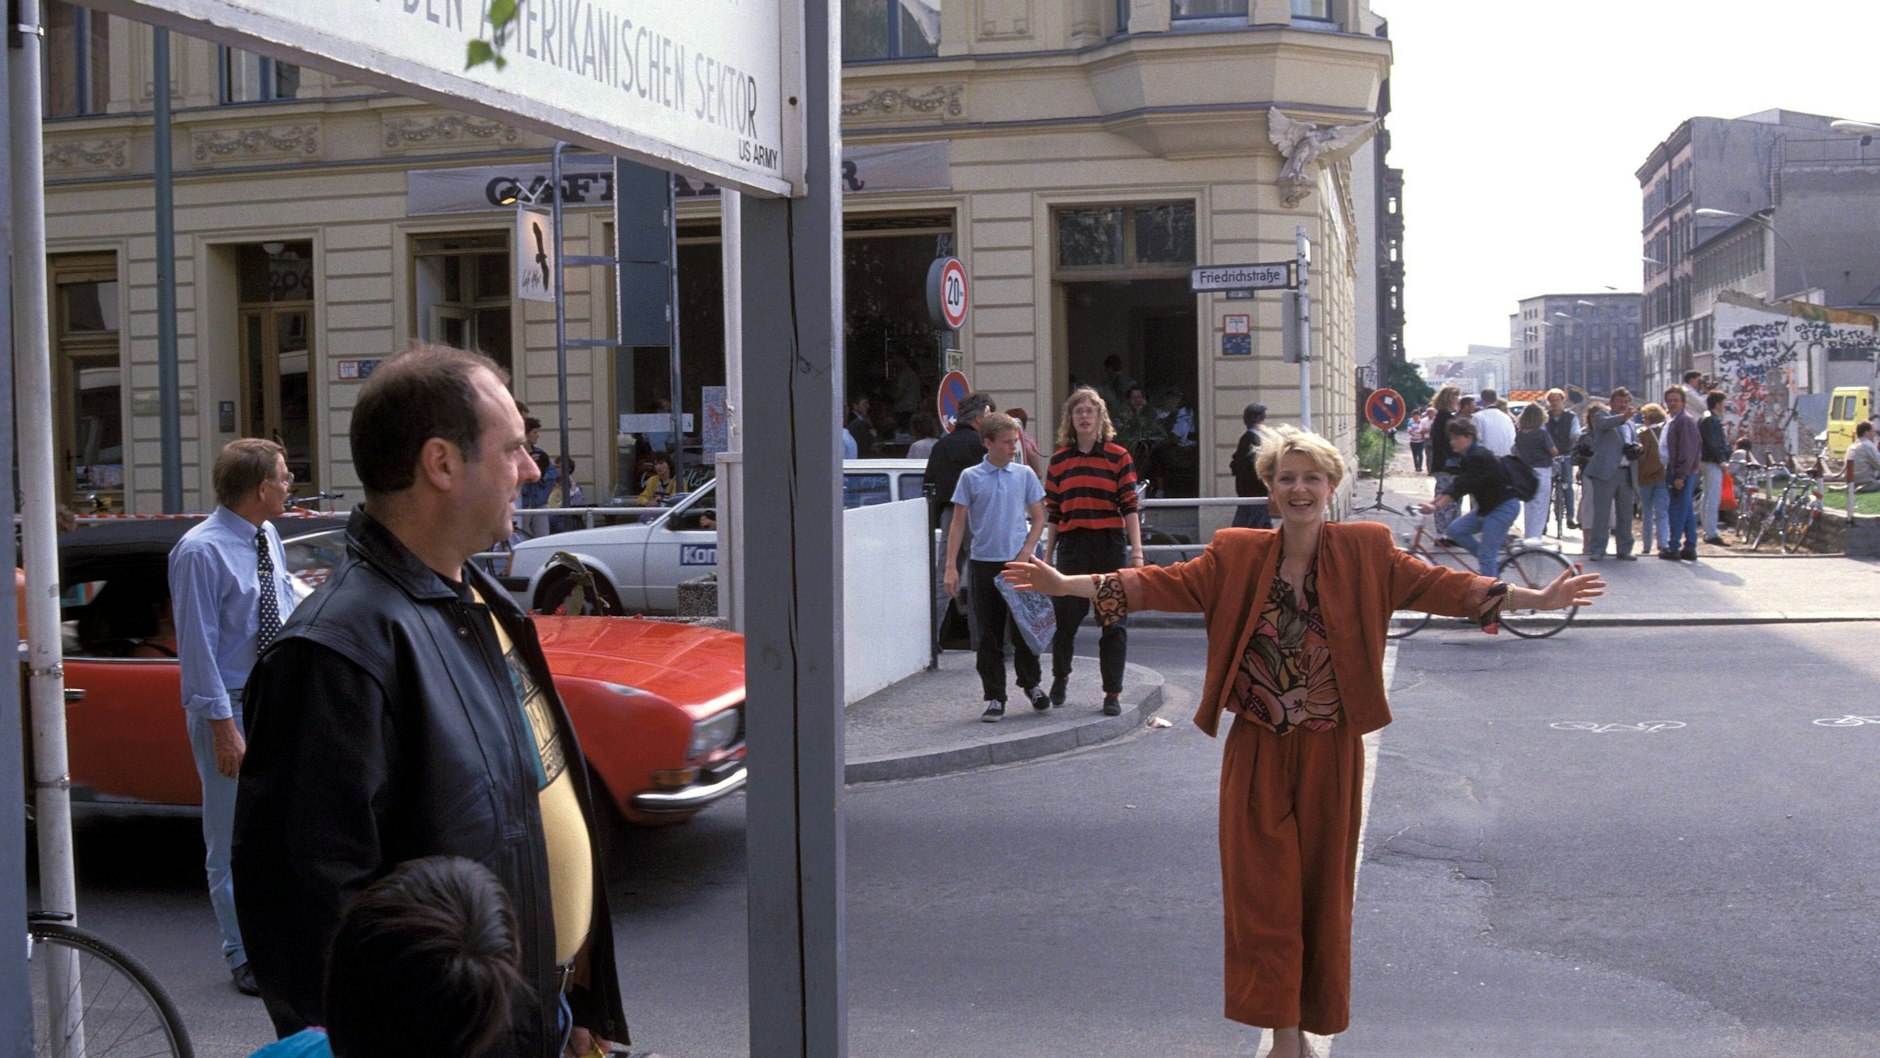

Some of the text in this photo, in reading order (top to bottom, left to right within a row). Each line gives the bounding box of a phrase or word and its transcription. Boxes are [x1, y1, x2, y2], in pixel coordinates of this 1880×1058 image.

[479, 0, 758, 139] ERIKANISCHEN SEKTOR
[738, 140, 779, 170] US ARMY
[947, 275, 960, 306] 20
[1200, 268, 1281, 283] Friedrichstraße
